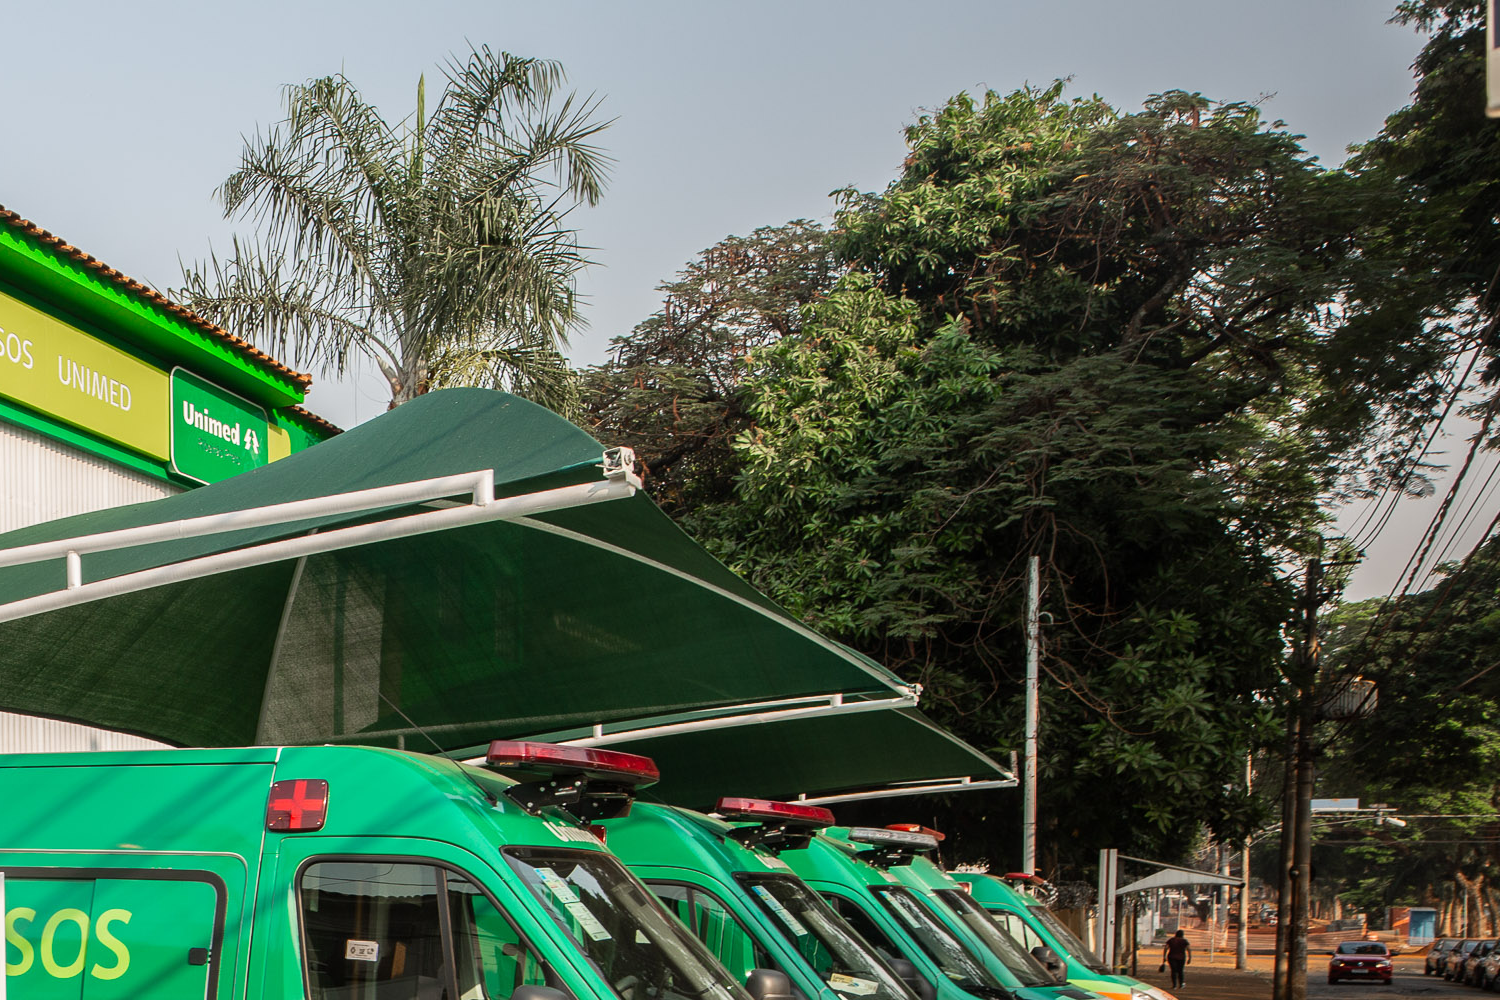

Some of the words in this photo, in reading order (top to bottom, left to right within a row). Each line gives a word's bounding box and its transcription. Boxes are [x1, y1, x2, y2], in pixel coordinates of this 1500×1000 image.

[58, 355, 132, 412] UNIMED
[183, 401, 240, 446] Unimed
[6, 907, 132, 980] SOS
